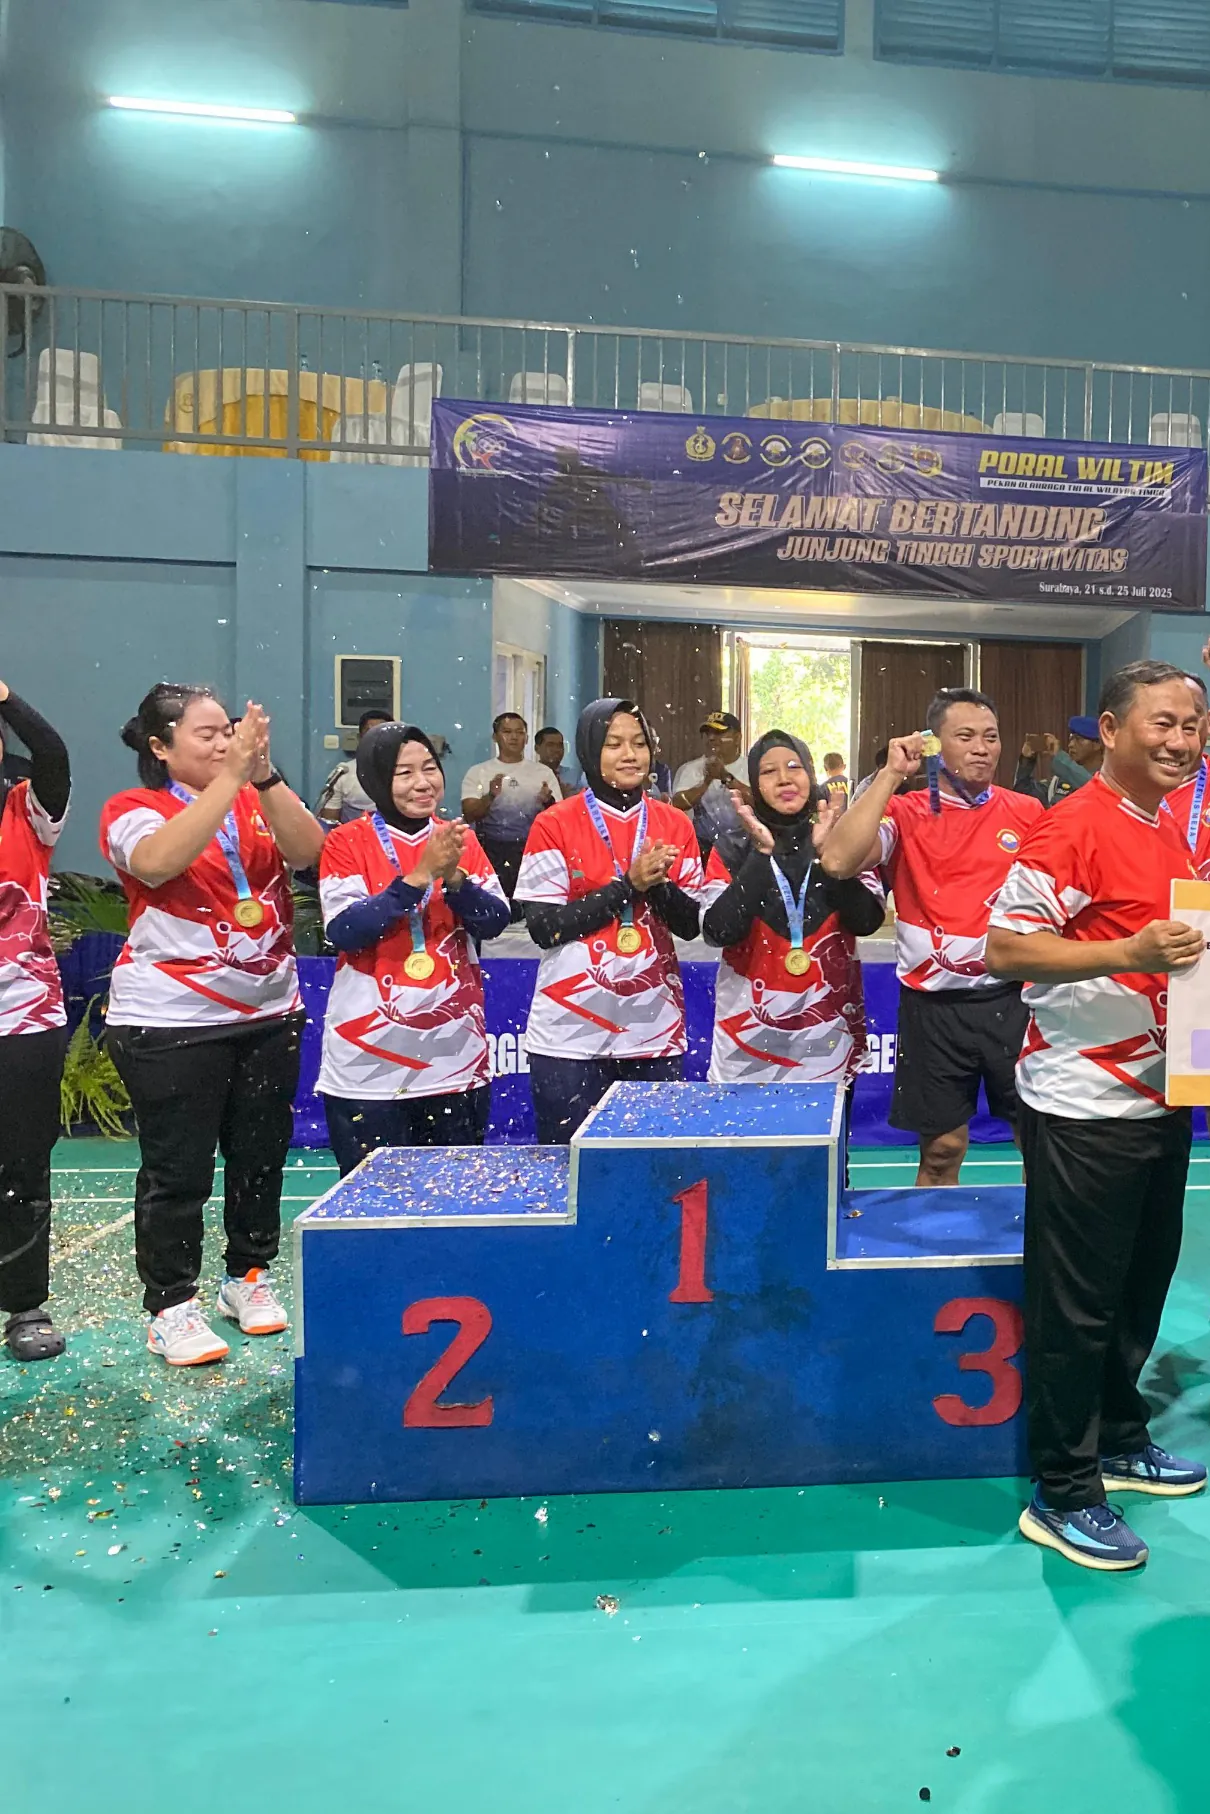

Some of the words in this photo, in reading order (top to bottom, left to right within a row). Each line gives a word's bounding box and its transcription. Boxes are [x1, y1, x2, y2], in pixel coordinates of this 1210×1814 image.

[978, 450, 1068, 479] PORAL
[1077, 457, 1174, 485] WILTIM
[987, 479, 1017, 488] PEKAN
[1018, 481, 1066, 491] OLAHRAGA
[715, 492, 887, 534] SELAMAT
[888, 499, 1107, 543] BERTANDING
[777, 536, 891, 564] JUNJUNG
[897, 540, 975, 567] TINGGI
[978, 544, 1128, 572] SPORTIVITAS
[1039, 582, 1082, 596] Surabaya,
[1084, 584, 1095, 595] 21
[1100, 585, 1114, 596] s.d.
[1117, 585, 1129, 596] 25
[1131, 586, 1146, 597] Juli
[1149, 587, 1172, 598] 2025
[586, 793, 602, 822] JUARA
[1193, 783, 1204, 809] TENIS
[1189, 812, 1198, 837] MEJA
[669, 1178, 713, 1302] 1
[402, 1296, 494, 1428] 2
[933, 1298, 1025, 1427] 3
